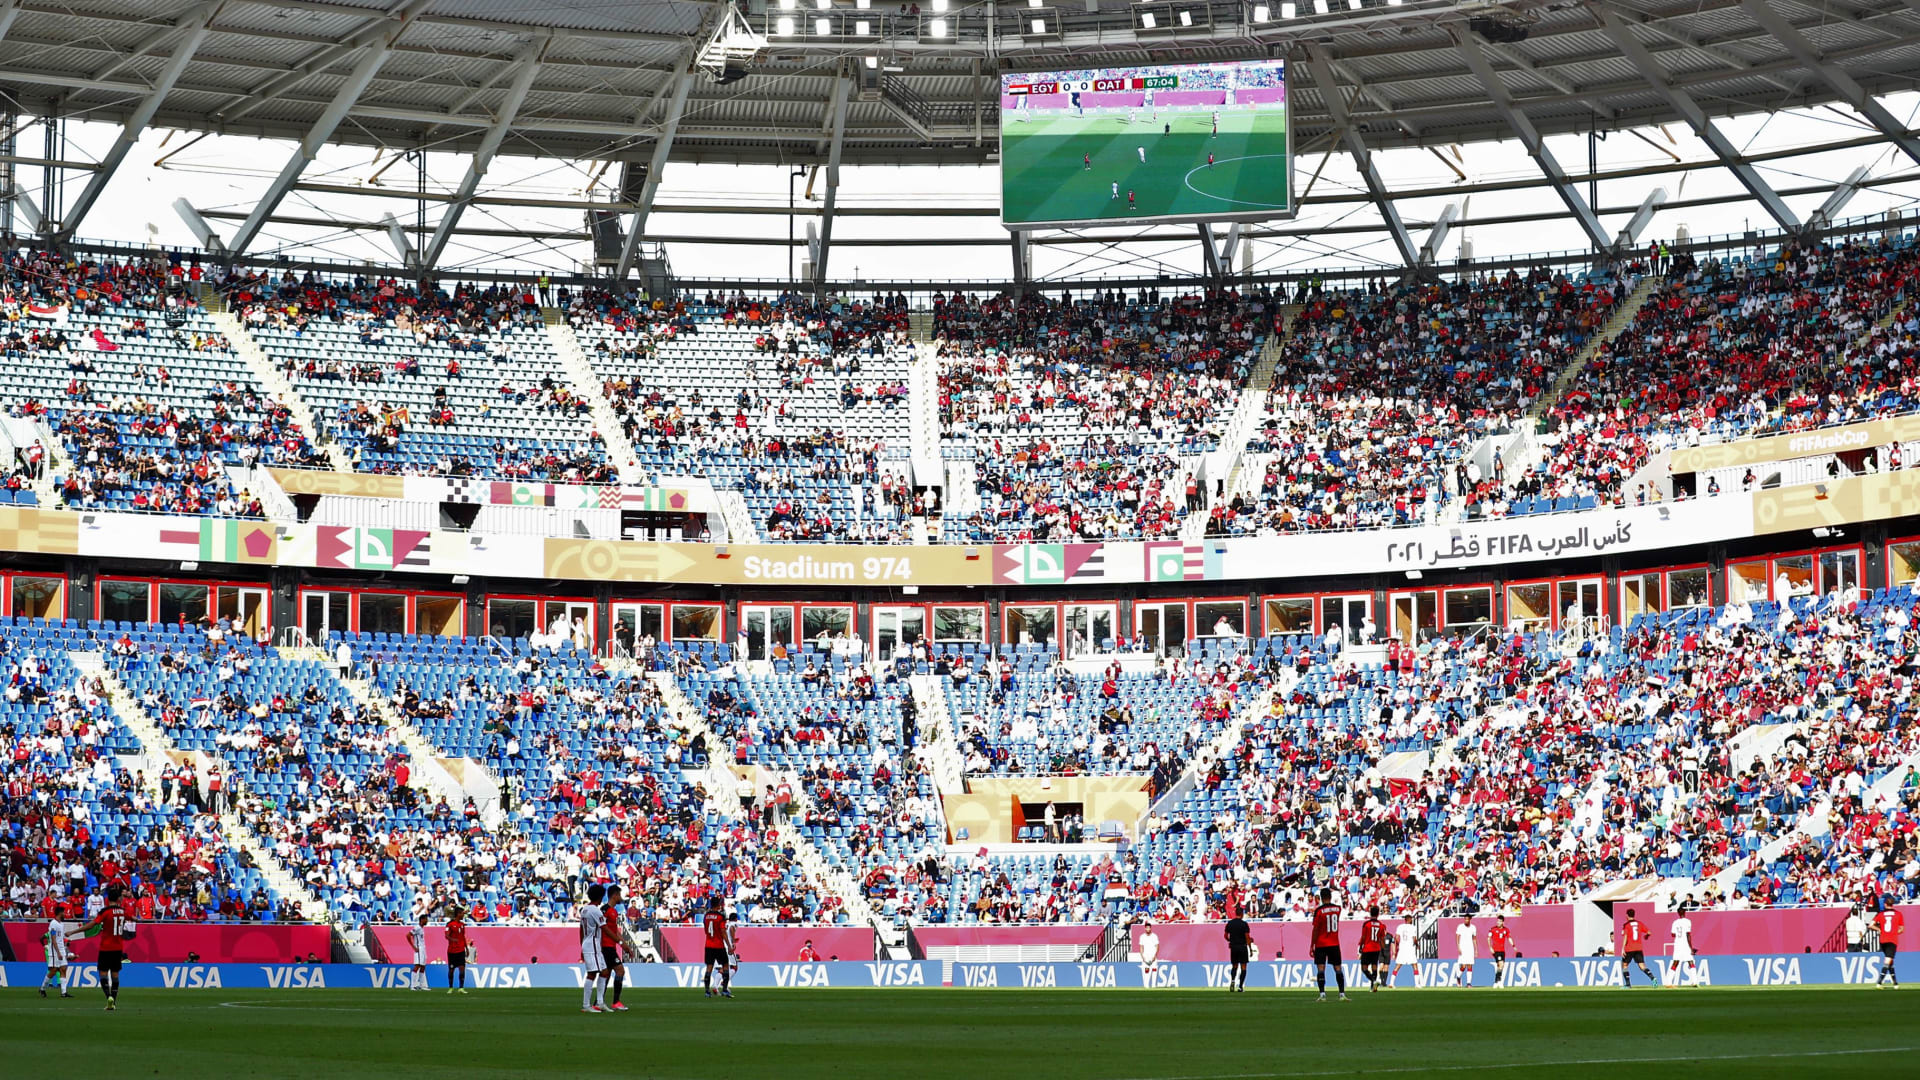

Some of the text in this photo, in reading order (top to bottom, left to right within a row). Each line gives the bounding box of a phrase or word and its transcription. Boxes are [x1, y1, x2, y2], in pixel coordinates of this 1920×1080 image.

[1031, 77, 1174, 94] EGY 0 0 QAT 67:04
[1789, 430, 1869, 452] #FIFArabCup
[1487, 534, 1533, 555] FIFA
[1537, 526, 1588, 556] العرب
[1593, 520, 1632, 550] كأس
[1387, 542, 1423, 563] ٢٠٢١
[744, 555, 912, 579] Stadium 974
[708, 920, 714, 937] 4
[1326, 914, 1338, 933] 18
[155, 966, 222, 988] VISA
[260, 966, 327, 988] VISA
[466, 967, 530, 988] VISA
[768, 965, 829, 987] VISA
[864, 964, 925, 986] VISA
[961, 966, 998, 988] VISA
[1018, 966, 1056, 988] VISA
[1077, 965, 1117, 987] VISA
[1269, 963, 1316, 988] VISA
[1569, 960, 1624, 986] VISA
[1742, 957, 1802, 985] VISA
